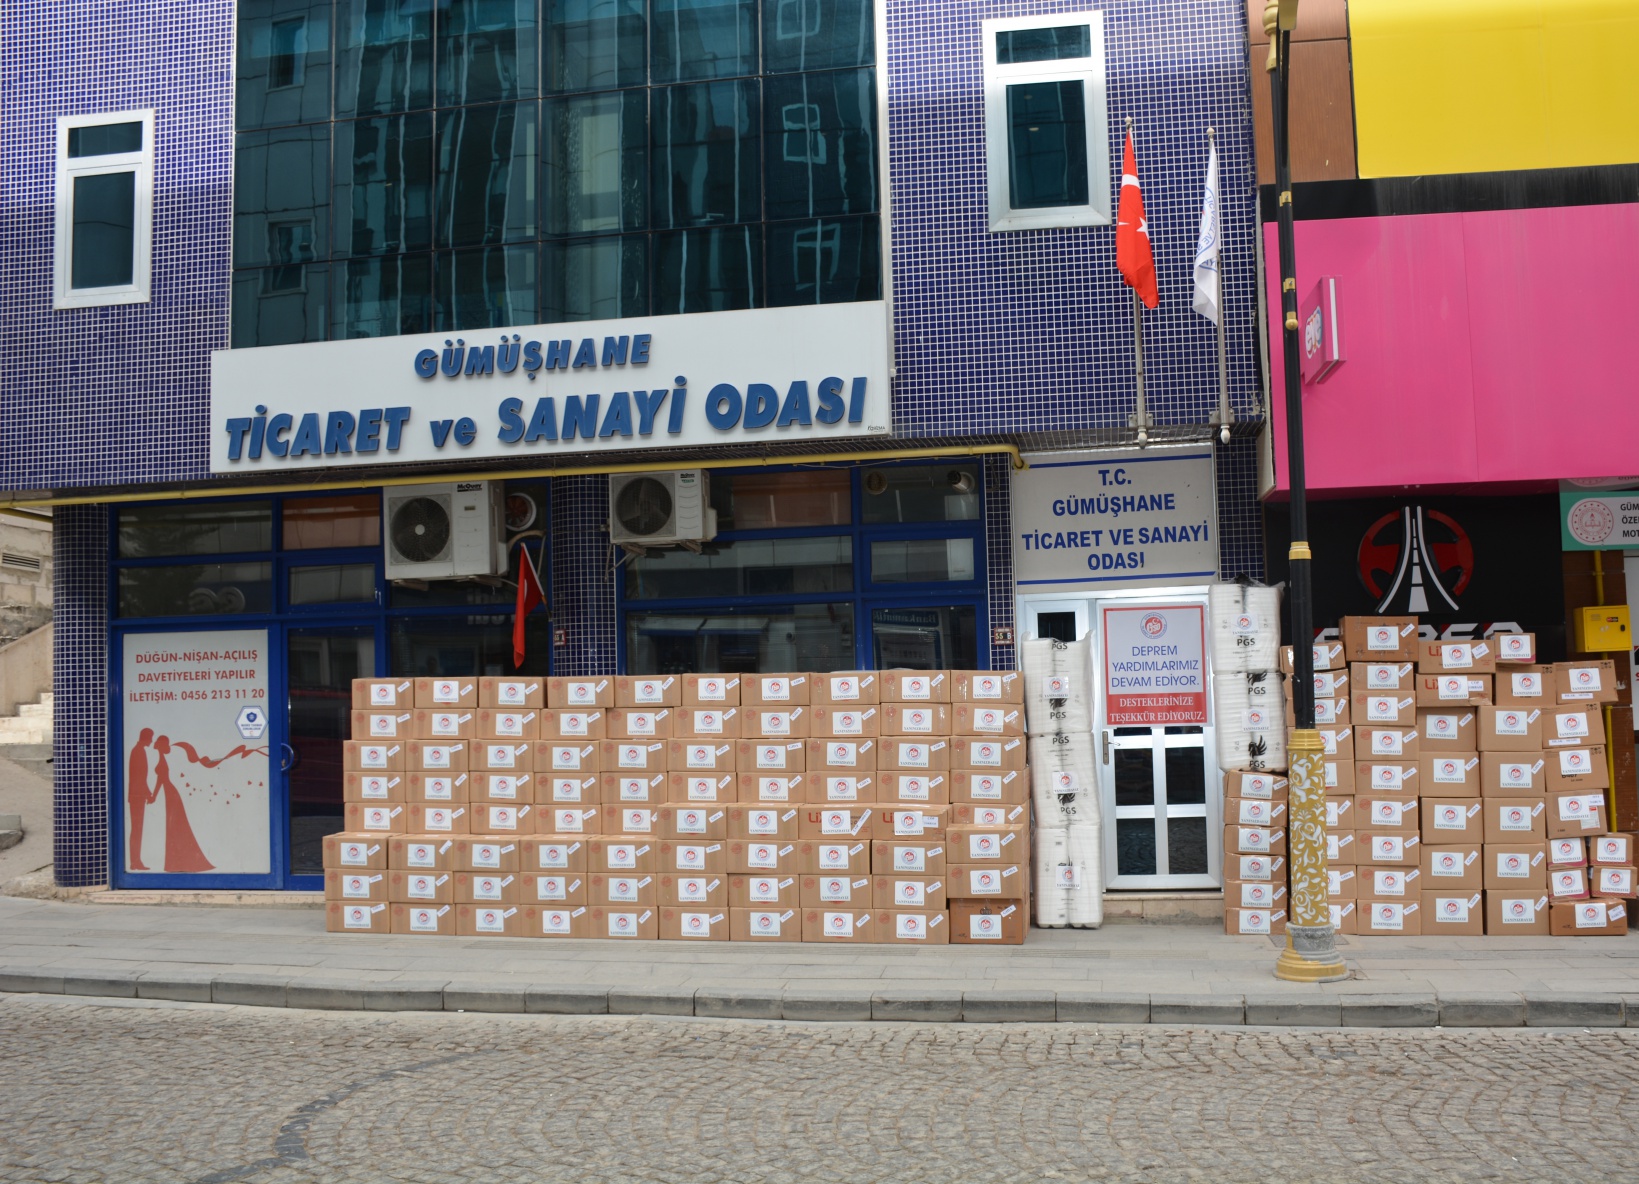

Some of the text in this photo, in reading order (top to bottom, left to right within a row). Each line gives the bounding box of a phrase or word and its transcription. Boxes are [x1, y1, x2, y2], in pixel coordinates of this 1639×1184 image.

[414, 333, 652, 381] GÜMÜŞHANE
[226, 376, 868, 461] TİCARET ve SANAYİ ODASI
[1098, 469, 1131, 486] T.C.
[1053, 494, 1175, 517] GÜMÜŞHANE
[1022, 520, 1208, 550] TİCARET VE SANAYİ
[1088, 552, 1144, 570] ODASI
[1237, 637, 1256, 646] PGS
[136, 650, 257, 664] DÜĞÜN-NİŞAN-AÇILIŞ
[1132, 646, 1177, 656] DEPREM
[1112, 660, 1198, 672] YARDIMLARIMIZ
[138, 668, 255, 682] DAVETİYELERİ YAPILIR
[1112, 674, 1199, 687] DEVAM EDİYOR.
[130, 688, 264, 704] İLETİŞİM: 0456 213 11 20
[1248, 686, 1266, 695] PGS
[1120, 696, 1193, 706] DESTEKLERİNİZE
[1050, 712, 1066, 720] PGS
[1110, 711, 1204, 724] TEŞEKKÜR EDİYORUZ.
[1053, 736, 1069, 744] PGS
[1249, 760, 1265, 769] PGS
[1060, 806, 1076, 815] PGS
